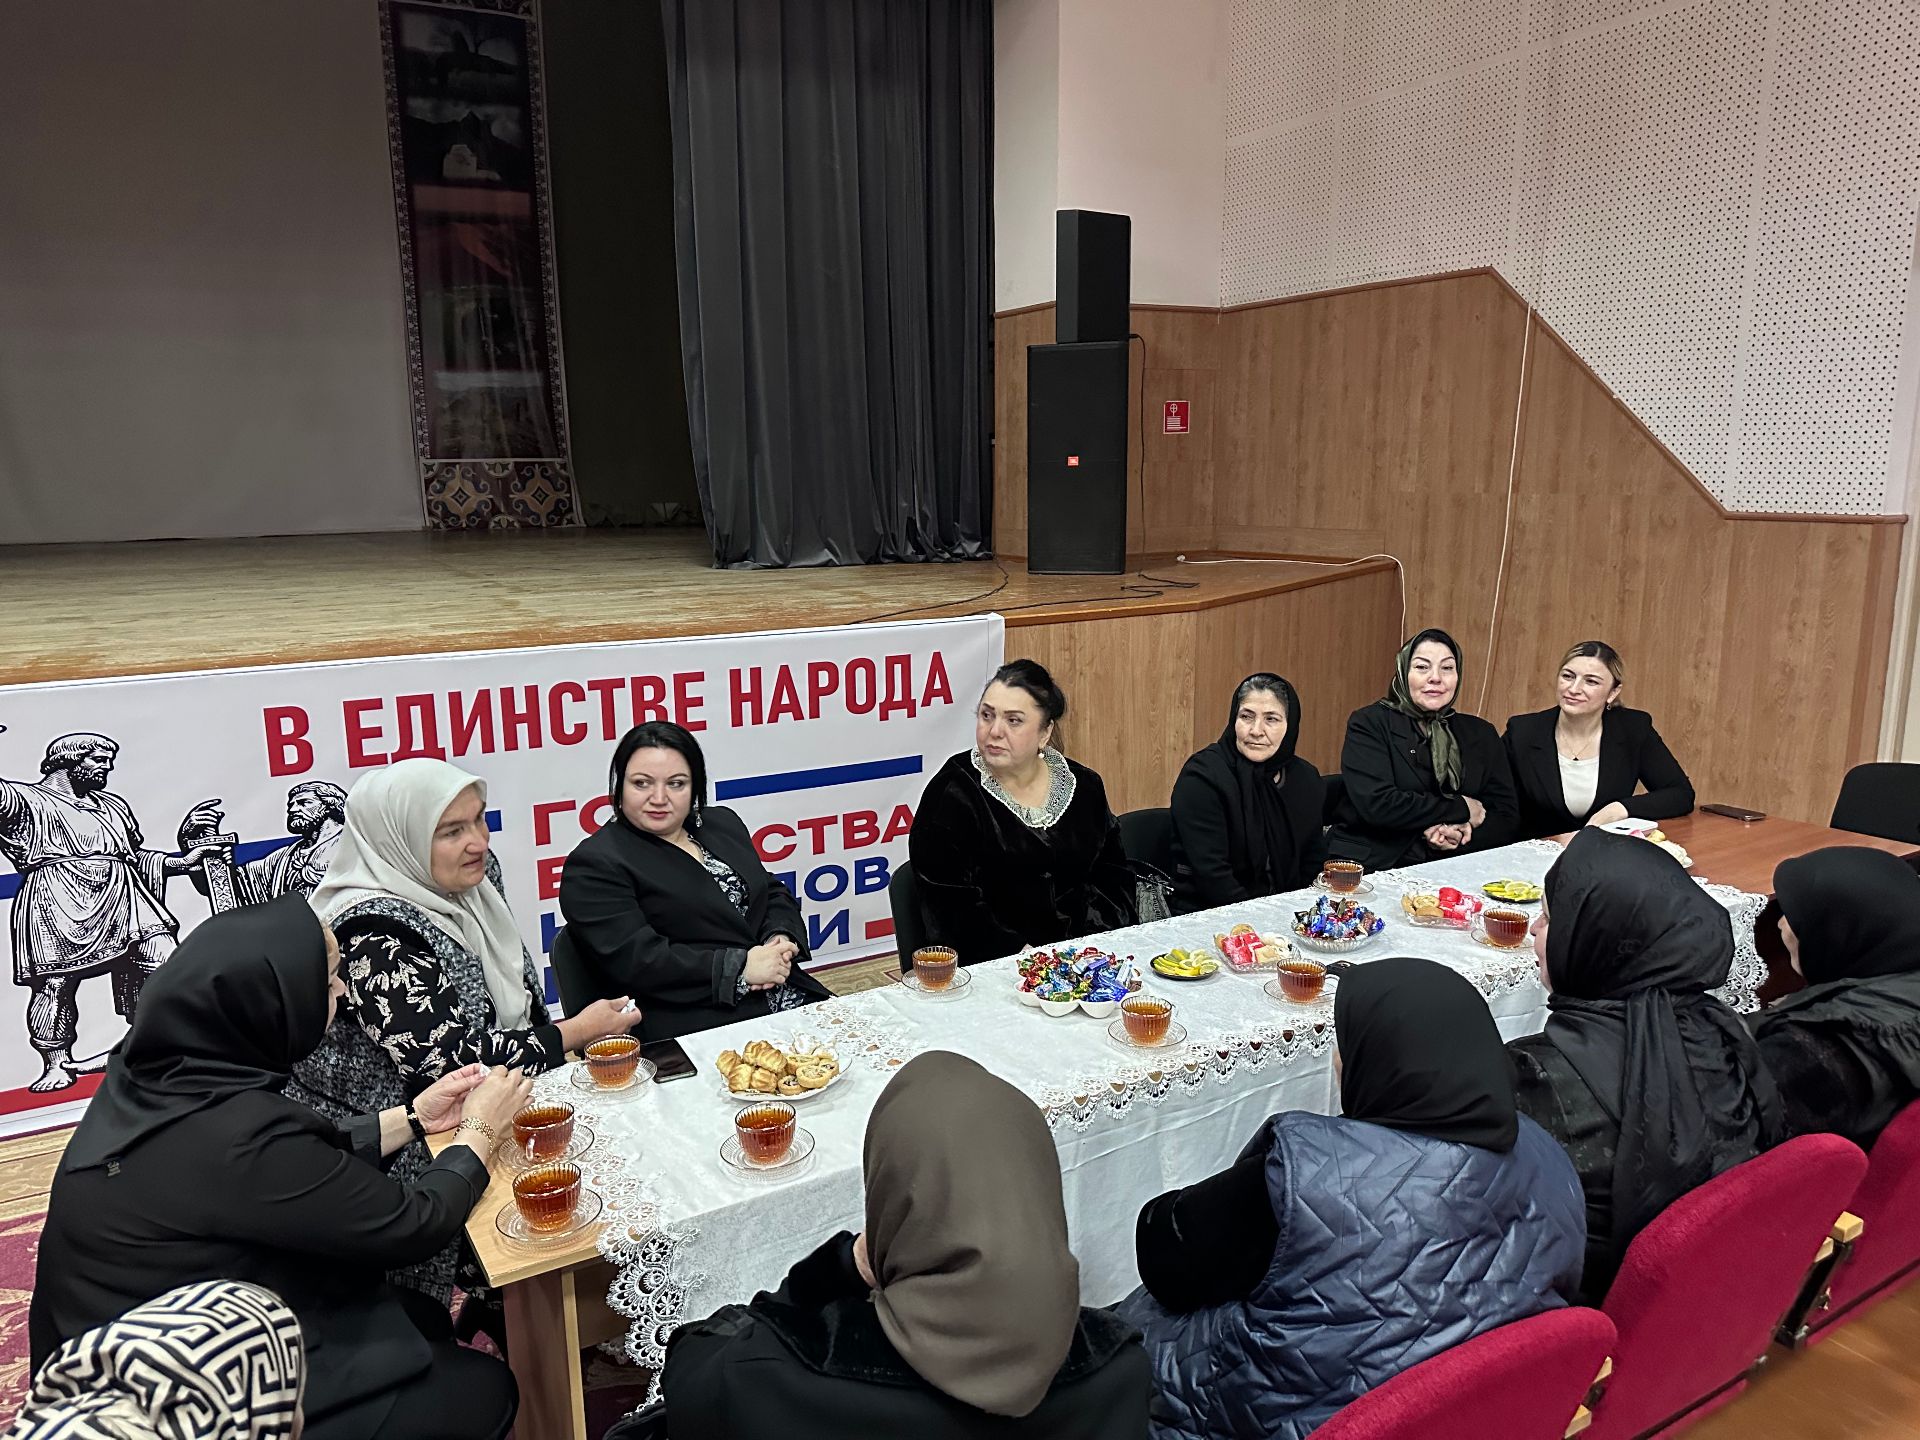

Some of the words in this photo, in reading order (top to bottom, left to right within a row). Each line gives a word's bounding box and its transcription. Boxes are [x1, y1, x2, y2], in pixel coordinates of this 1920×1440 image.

[263, 705, 315, 778] В
[342, 671, 708, 769] ЕДИНСТВЕ
[728, 651, 954, 728] НАРОДА
